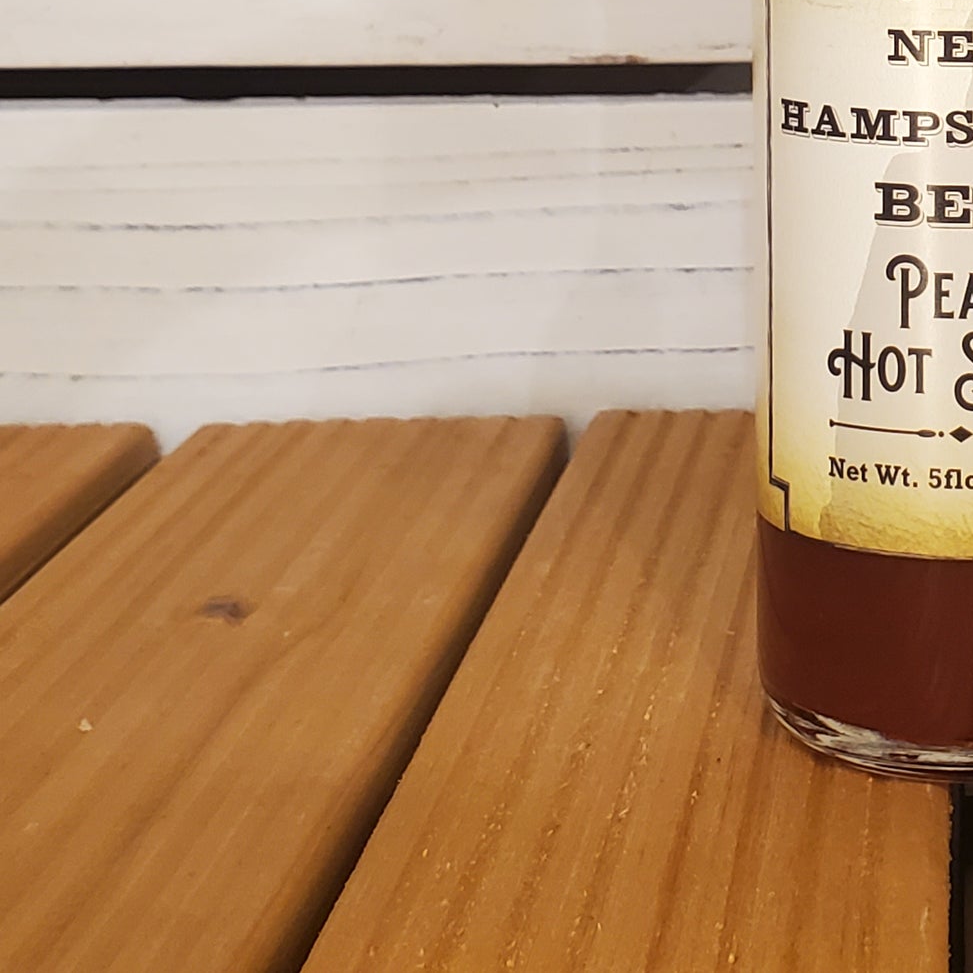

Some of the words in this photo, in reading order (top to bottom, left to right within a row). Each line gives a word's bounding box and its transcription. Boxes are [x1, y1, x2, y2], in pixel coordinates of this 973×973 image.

[827, 329, 933, 401] HOT
[828, 456, 869, 483] Net
[875, 465, 919, 488] Wt.
